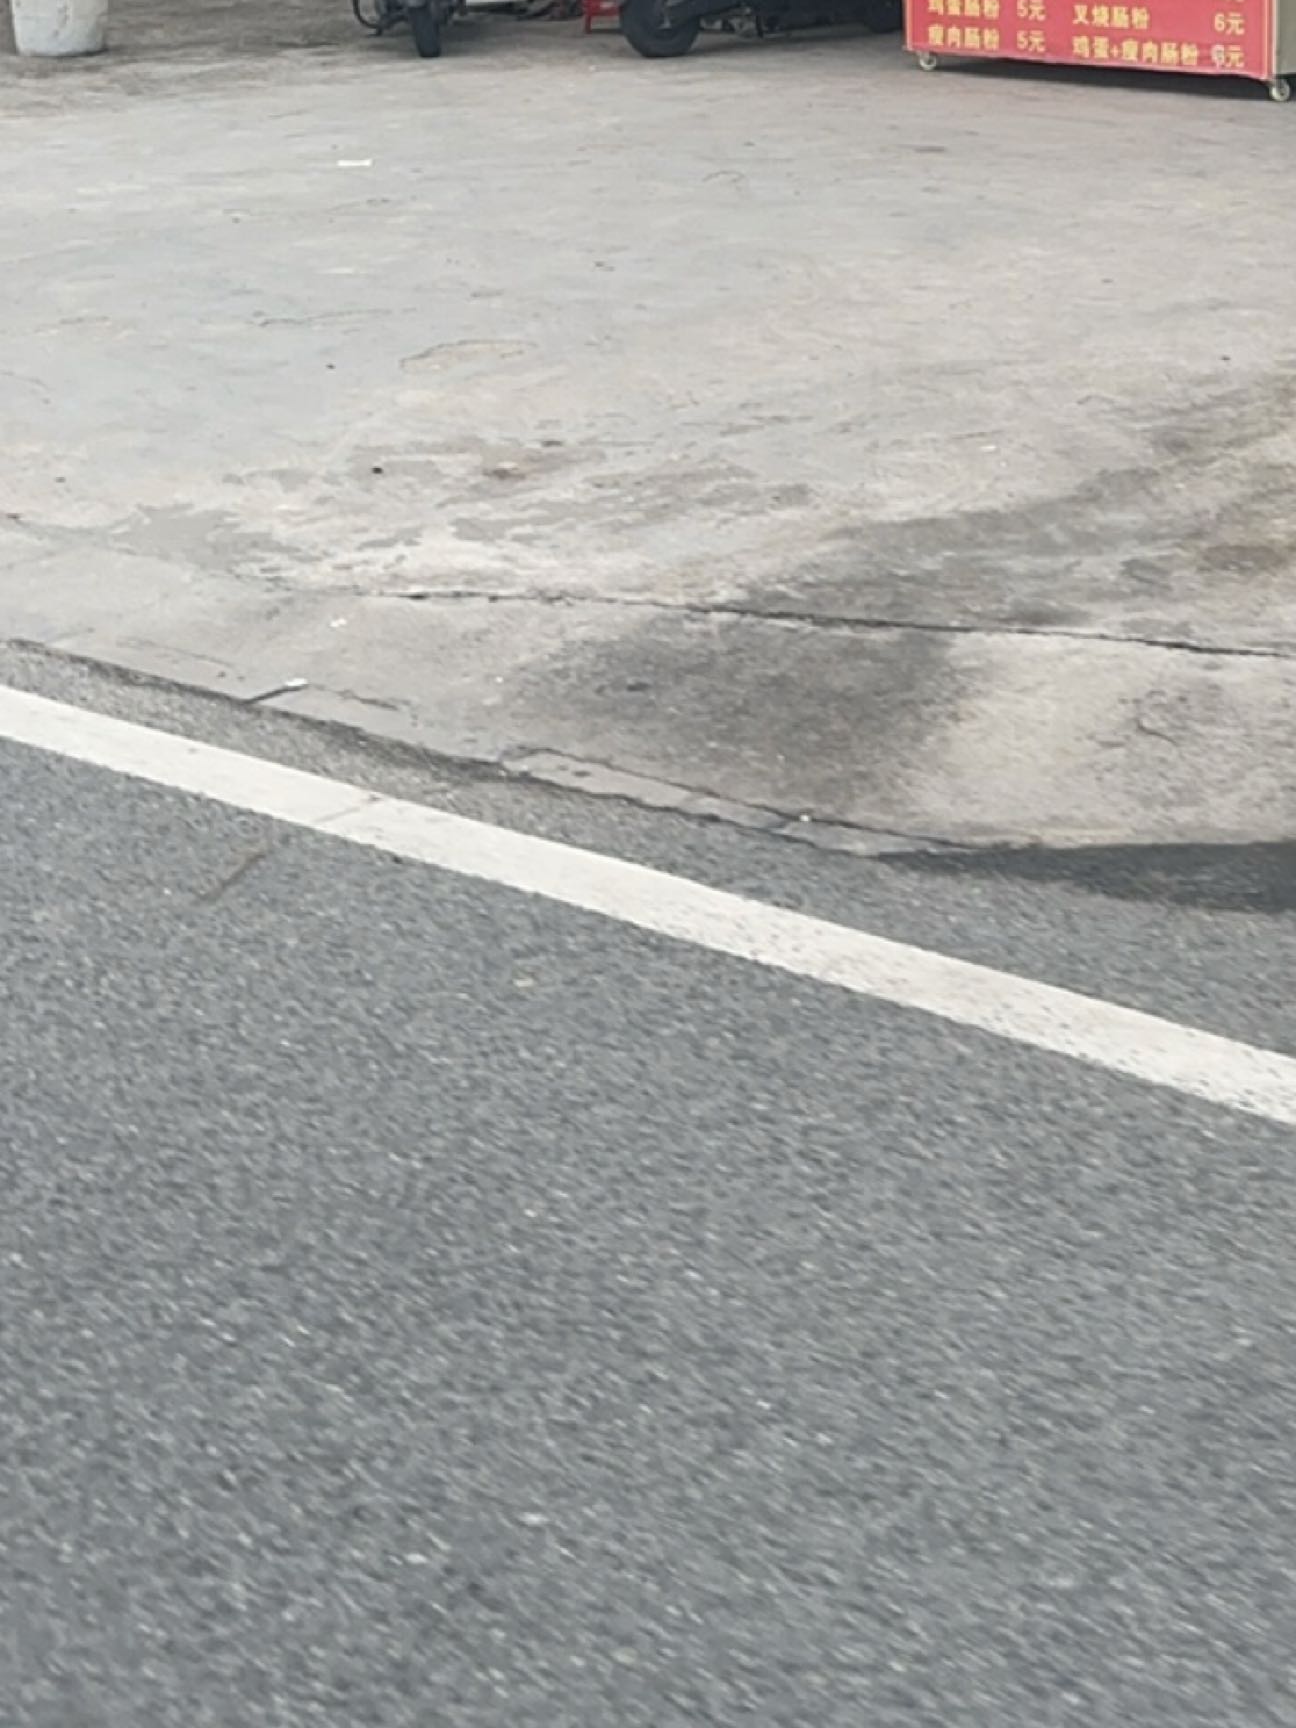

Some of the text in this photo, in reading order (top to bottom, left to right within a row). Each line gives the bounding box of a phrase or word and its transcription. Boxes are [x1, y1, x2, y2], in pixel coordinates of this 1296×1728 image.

[1016, 0, 1047, 22] 5元
[1072, 4, 1246, 36] 叉烧肠粉 6元
[928, 23, 1047, 53] 瘦肉肠粉 5元
